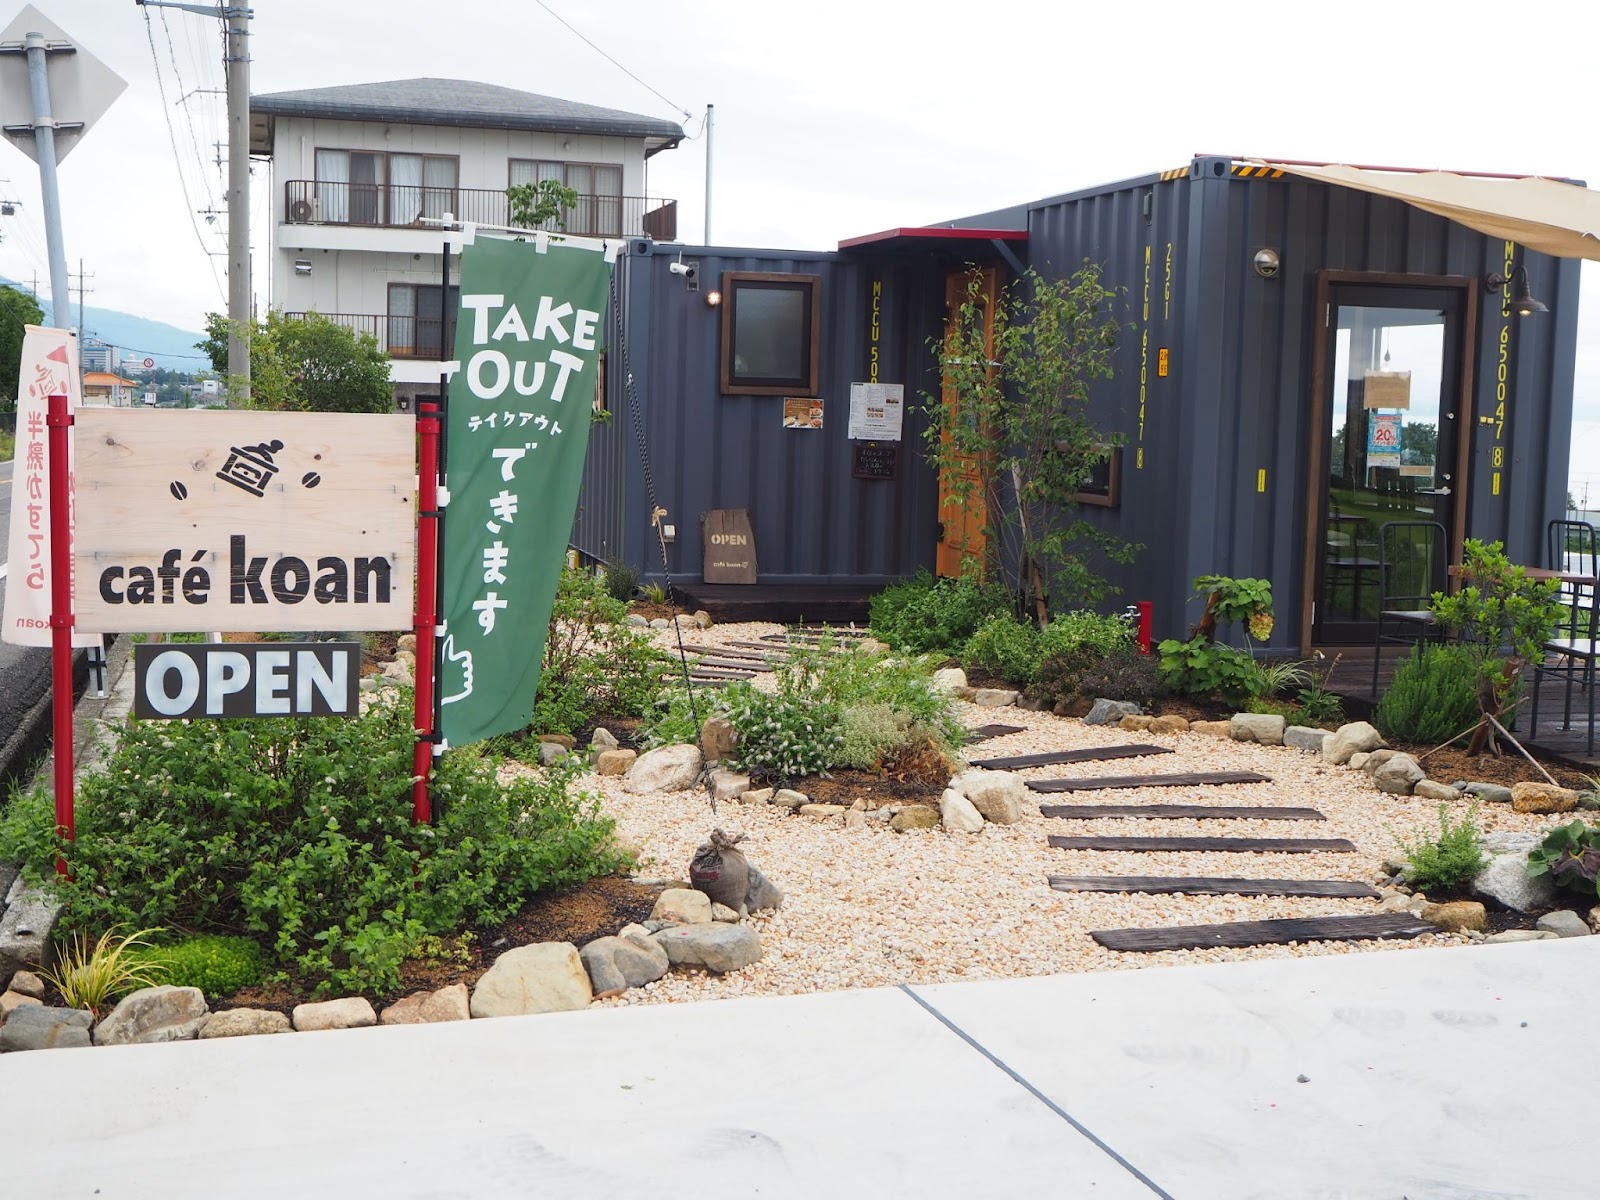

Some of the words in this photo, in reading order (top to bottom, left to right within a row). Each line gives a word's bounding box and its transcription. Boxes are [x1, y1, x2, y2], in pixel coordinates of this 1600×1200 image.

[1143, 246, 1151, 321] MCCU
[1502, 240, 1515, 317] MCCU
[462, 294, 600, 351] TAKE
[872, 281, 881, 342] MCCU
[467, 350, 585, 403] OUT
[1139, 329, 1149, 441] 650047
[1495, 325, 1509, 439] 650047
[468, 411, 563, 436] テイクアウト
[1137, 448, 1143, 468] 8
[1493, 448, 1503, 467] 8
[99, 549, 211, 605] café
[230, 535, 391, 605] koan
[472, 442, 538, 636] できます
[711, 534, 747, 545] OPEN
[145, 650, 348, 716] OPEN
